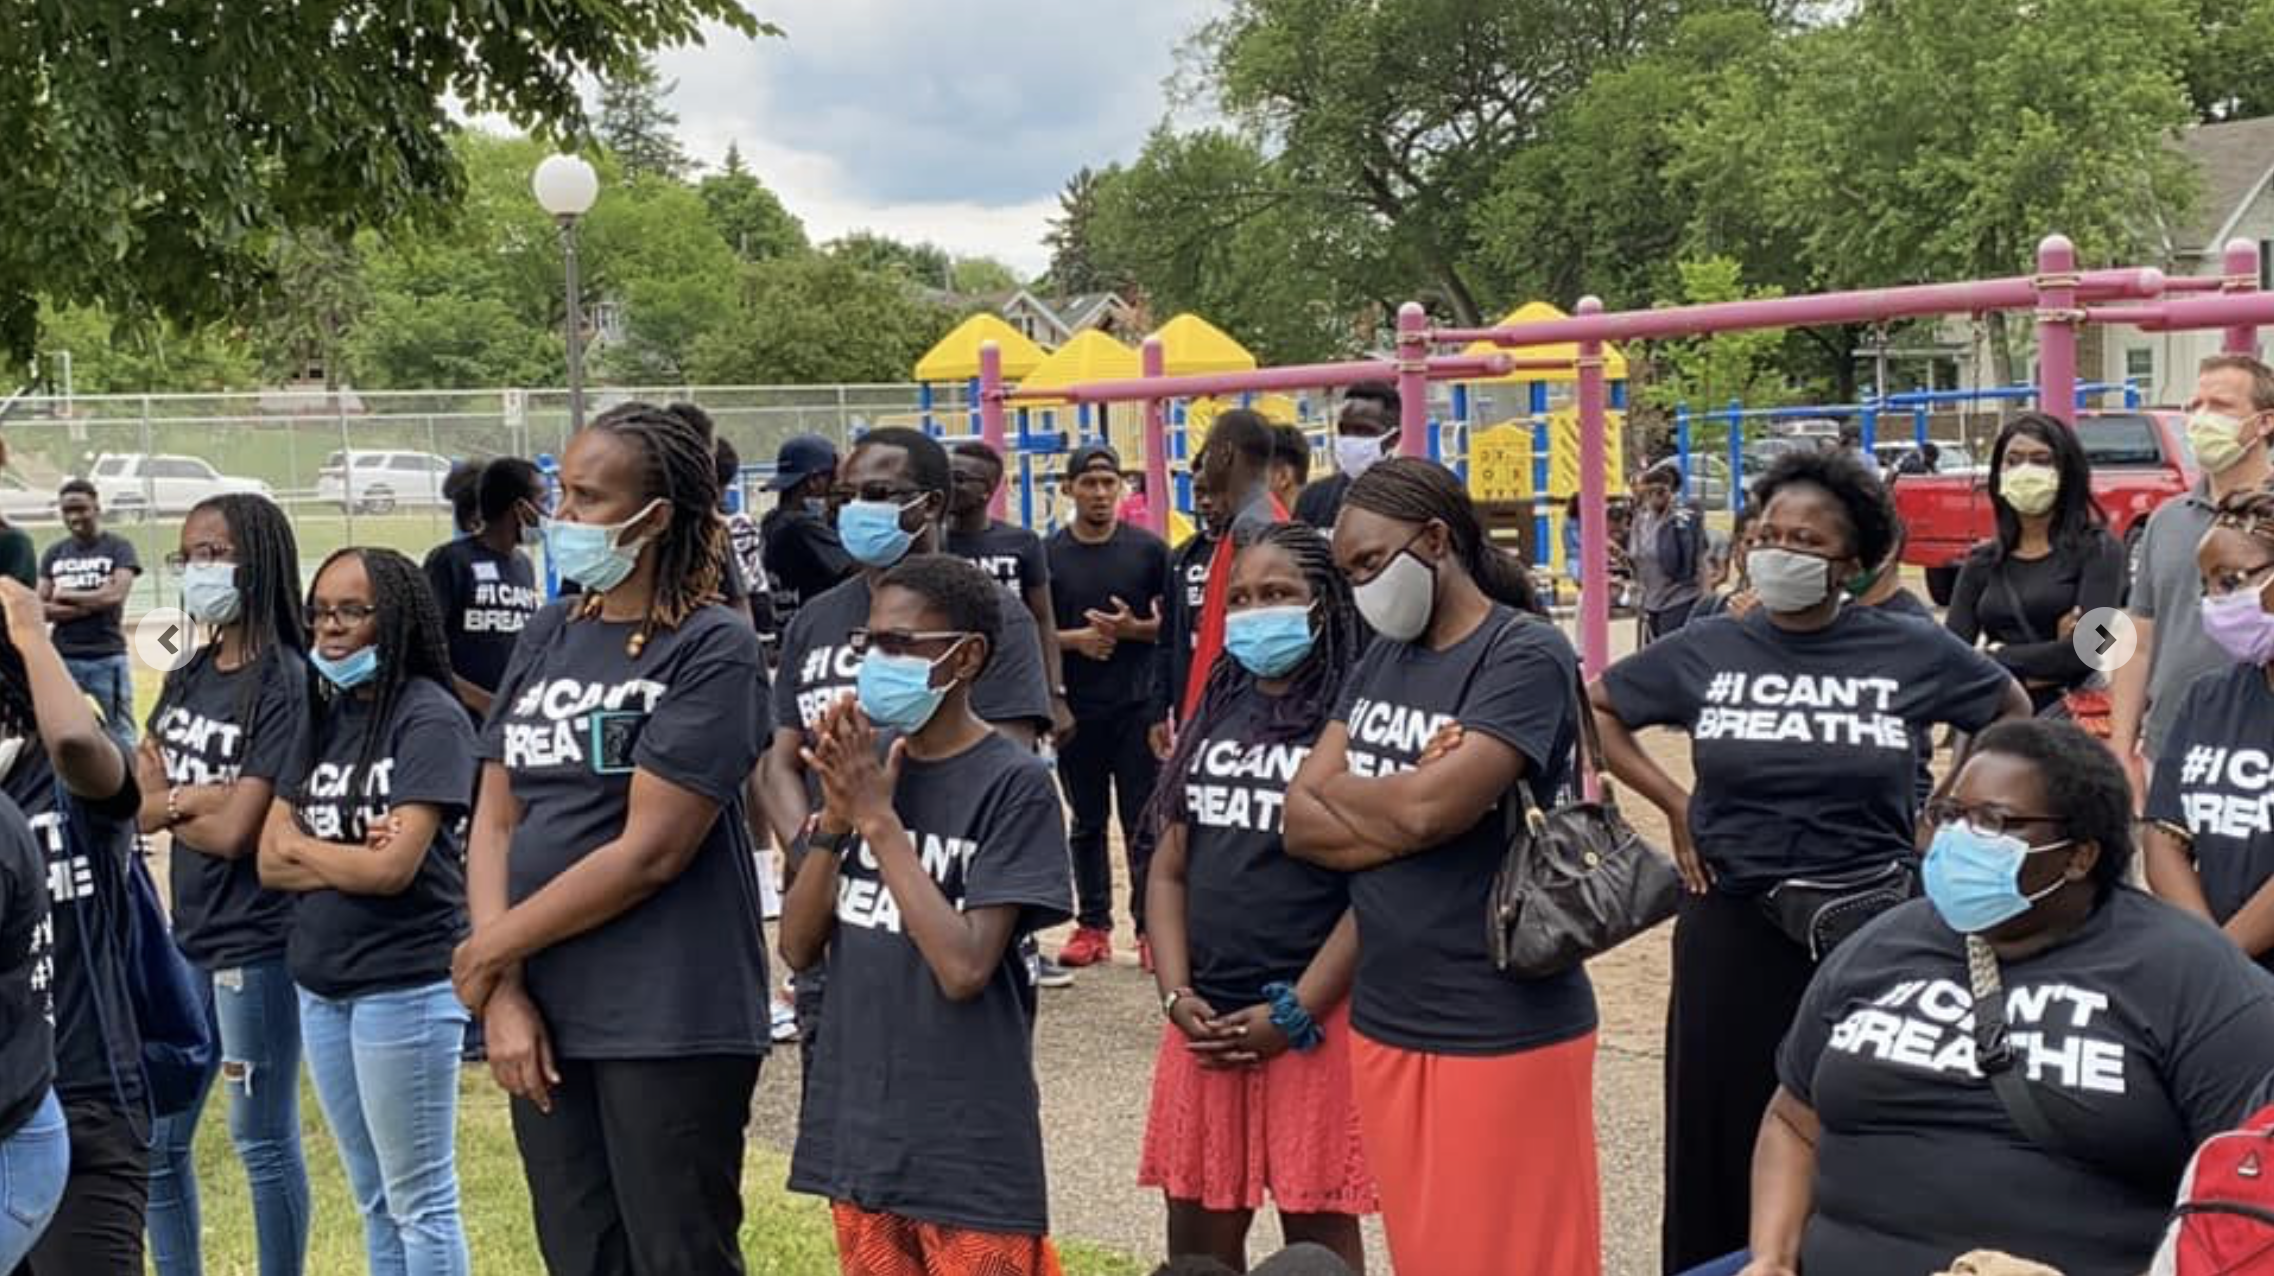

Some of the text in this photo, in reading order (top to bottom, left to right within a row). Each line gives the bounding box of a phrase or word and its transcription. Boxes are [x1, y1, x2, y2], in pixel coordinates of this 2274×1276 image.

[463, 608, 531, 632] BREA
[1706, 671, 1899, 710] #I CAN'T
[1694, 707, 1909, 749] BREATHE
[2180, 744, 2228, 784] #I
